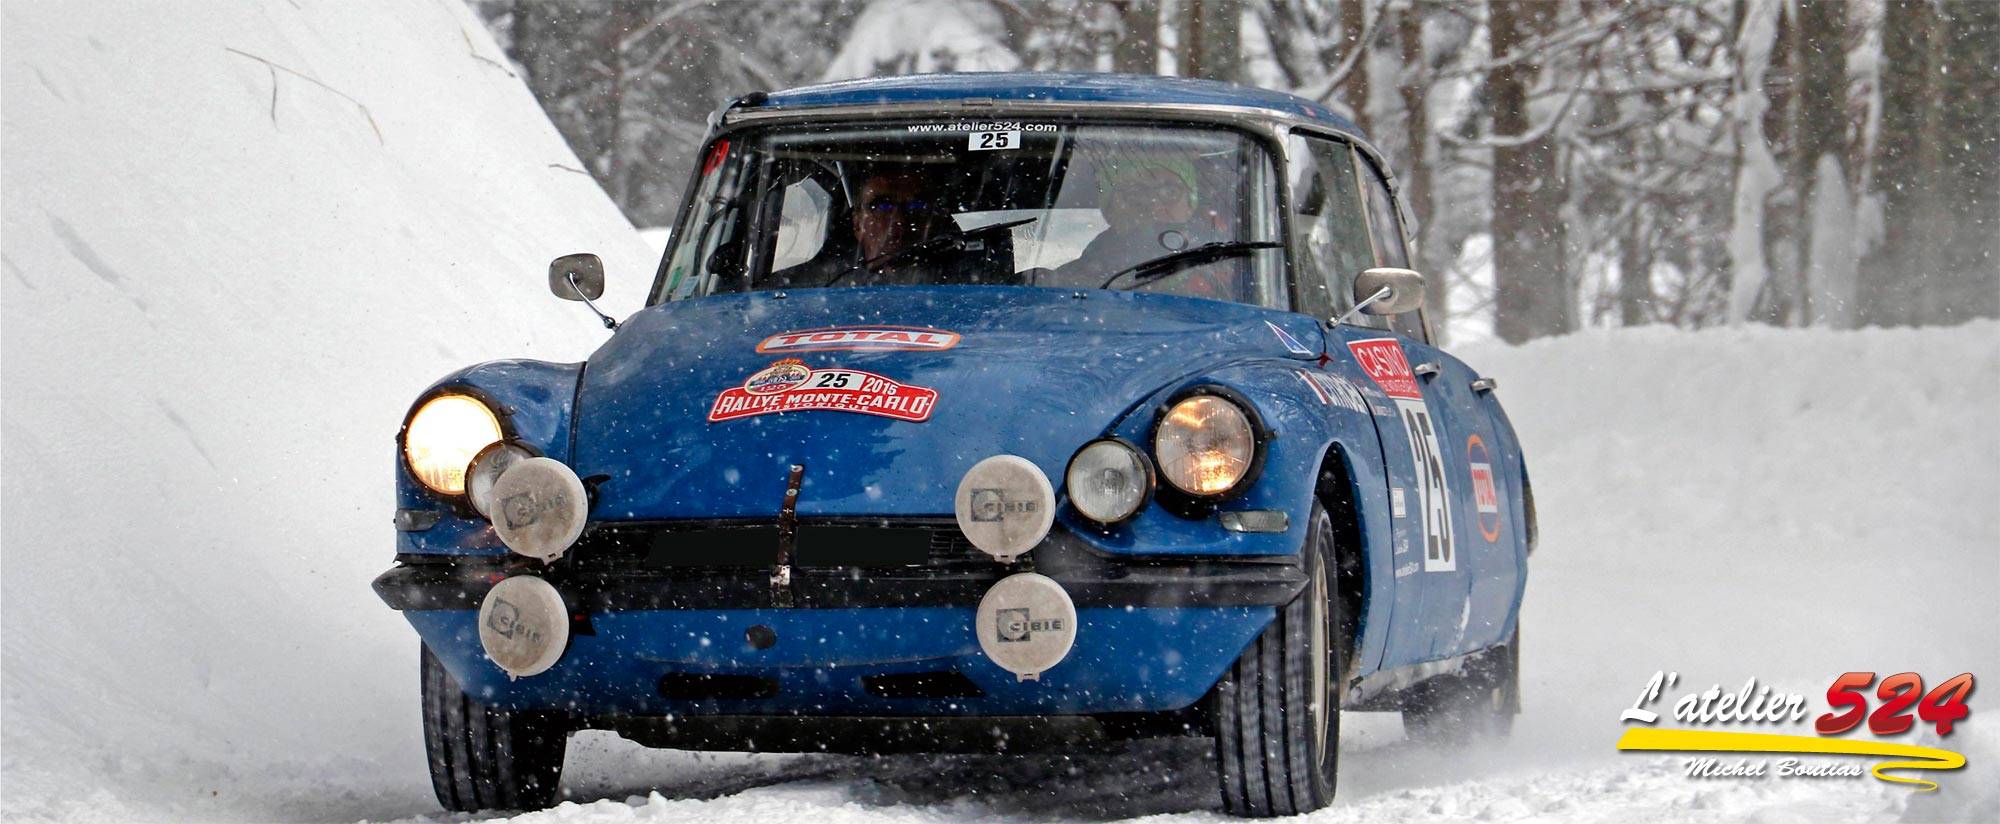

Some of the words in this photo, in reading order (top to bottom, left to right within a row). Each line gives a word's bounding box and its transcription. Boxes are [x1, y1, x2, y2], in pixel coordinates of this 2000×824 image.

[907, 121, 1057, 132] www.atelier524.com
[980, 132, 1009, 149] 25
[779, 331, 942, 346] TOTAL
[1357, 345, 1410, 378] CASINO
[816, 373, 851, 388] 25
[863, 376, 899, 396] 2015
[716, 394, 782, 415] RALLYE
[787, 393, 931, 414] MONTE-CARLO
[763, 401, 870, 412] HISTORIQUE
[1406, 408, 1450, 563] 25
